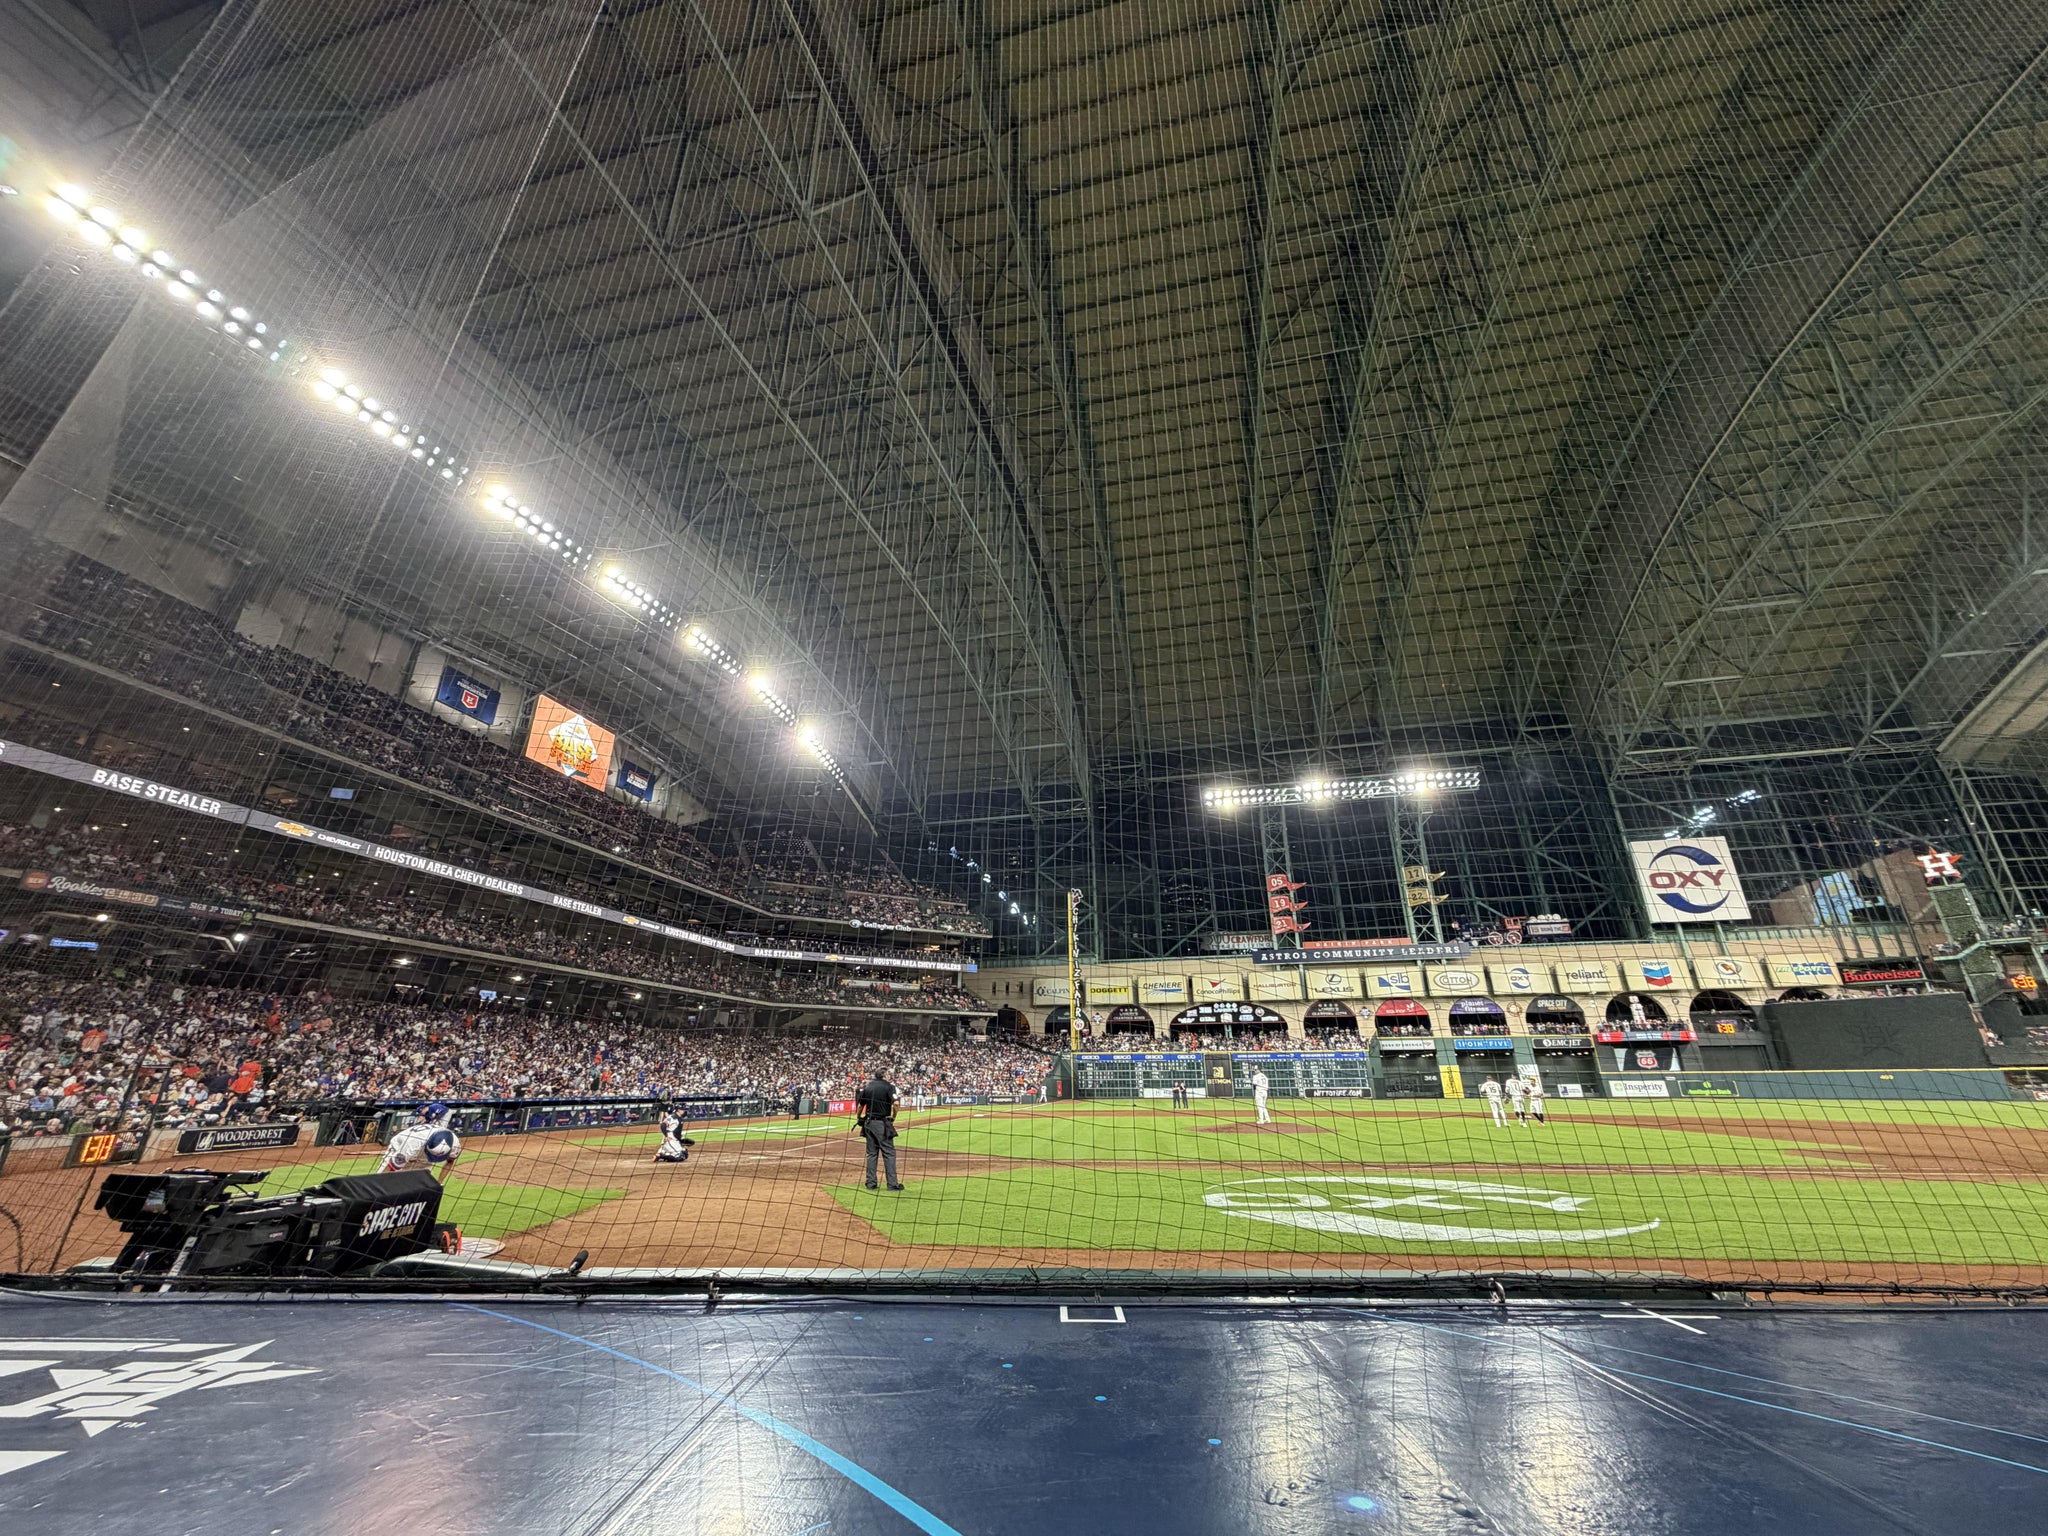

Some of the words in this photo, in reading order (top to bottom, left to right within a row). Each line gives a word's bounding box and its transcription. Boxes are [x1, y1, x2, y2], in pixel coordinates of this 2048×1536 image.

[92, 769, 144, 794] BASE
[144, 784, 221, 815] STEALER
[374, 846, 427, 870] HOUSTON
[425, 861, 453, 877] AREA
[453, 868, 486, 886] CHEVY
[485, 876, 524, 895] DEALERS
[1407, 869, 1420, 879] 17
[1649, 869, 1726, 889] OXY
[48, 876, 104, 896] Rookies
[1274, 898, 1286, 907] 19
[1411, 892, 1424, 901] 22
[553, 895, 573, 909] BASE
[572, 901, 602, 917] STEALER
[863, 921, 895, 931] Gallagher
[895, 924, 912, 932] Club
[1276, 920, 1288, 929] 21
[665, 926, 689, 939] HOUSTON
[689, 932, 701, 942] AREA
[701, 936, 717, 947] CHEVY
[716, 940, 736, 951] DEALERS
[754, 948, 773, 958] BASE
[773, 949, 803, 959] STEALER
[1261, 953, 1307, 961] ASTROS
[1313, 949, 1394, 959] COMMUNITY
[1402, 946, 1460, 956] LEADERS
[873, 957, 901, 966] HOUSTON
[901, 959, 917, 968] AREA
[917, 961, 936, 970] CHEVY
[936, 962, 961, 971] DEALERS
[1390, 972, 1410, 984] slb
[1566, 969, 1605, 980] reliant
[1843, 968, 1922, 983] Budweiser
[1143, 981, 1182, 989] CHENIERE
[1196, 988, 1241, 996] ConocoPhillips
[1537, 1000, 1554, 1008] SPACE
[1554, 1000, 1567, 1008] CITY
[1624, 1082, 1663, 1092] Insperity
[216, 1128, 286, 1143] WOODFOREST
[396, 1201, 427, 1227] CITY
